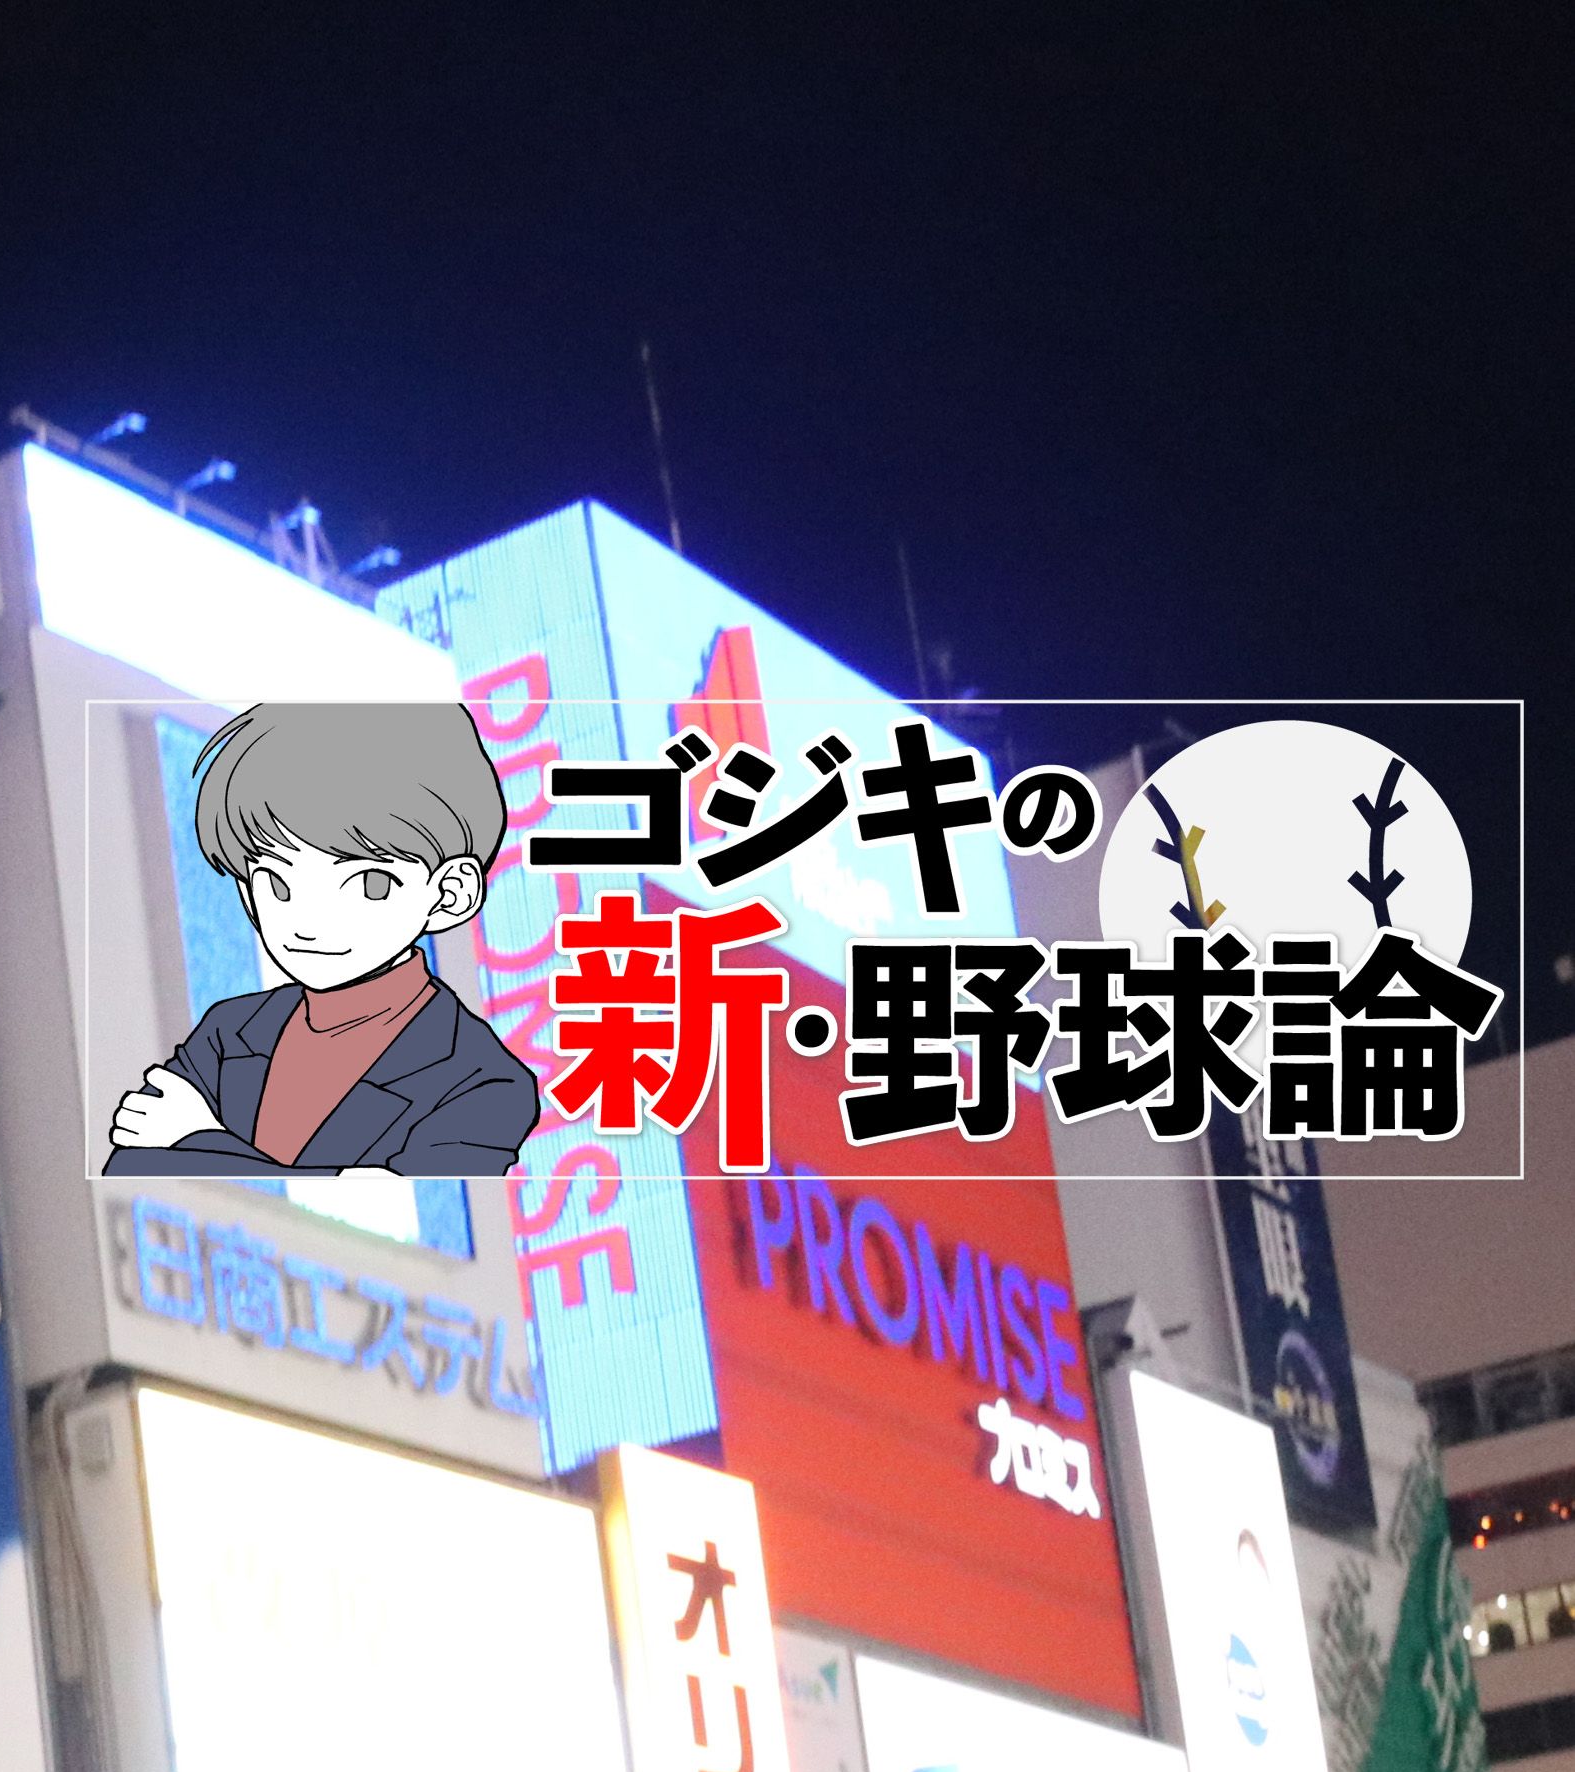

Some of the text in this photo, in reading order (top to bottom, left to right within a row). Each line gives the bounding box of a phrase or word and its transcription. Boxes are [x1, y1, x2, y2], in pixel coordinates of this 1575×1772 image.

[131, 1194, 541, 1418] 日商エステム
[746, 1152, 1086, 1422] PROMISE
[977, 1397, 1102, 1520] プロミス
